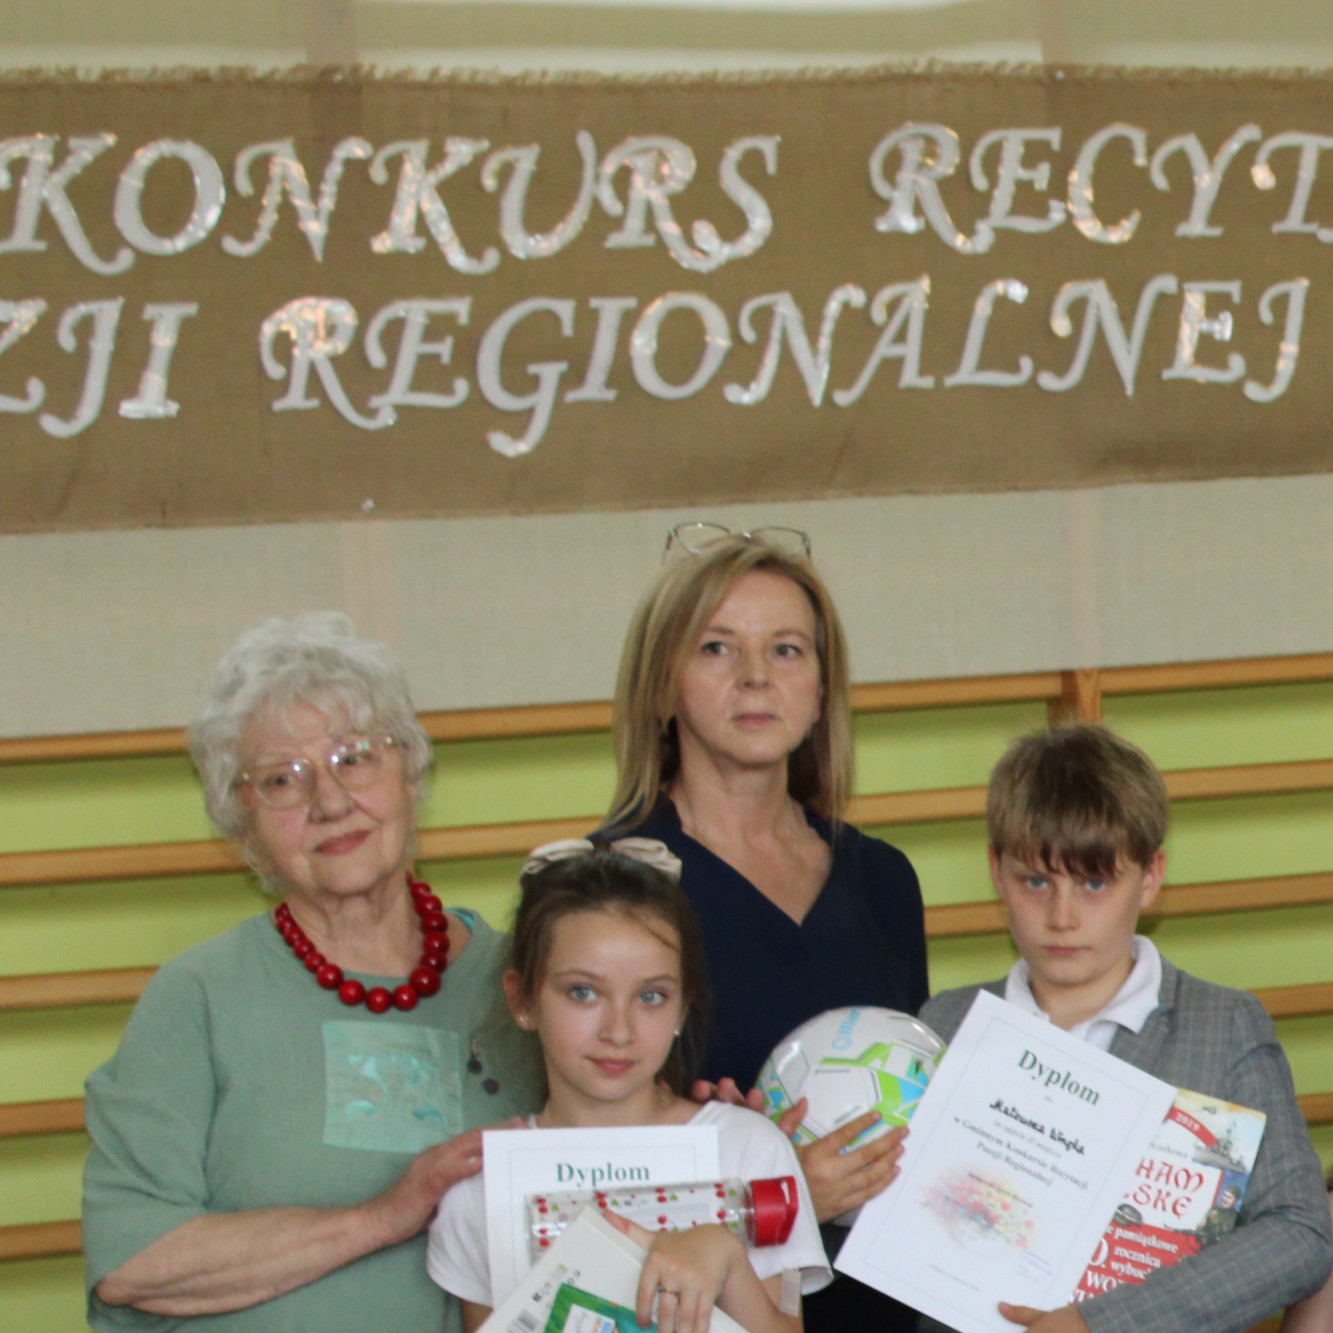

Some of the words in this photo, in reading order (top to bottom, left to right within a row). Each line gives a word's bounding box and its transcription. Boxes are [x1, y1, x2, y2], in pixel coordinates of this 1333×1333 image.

[0, 130, 781, 275] KONKURS
[259, 274, 1310, 458] REGIONALNEJ
[1017, 1049, 1100, 1106] Dyplom
[556, 1162, 650, 1187] Dyplom
[1114, 1246, 1161, 1268] rocznica
